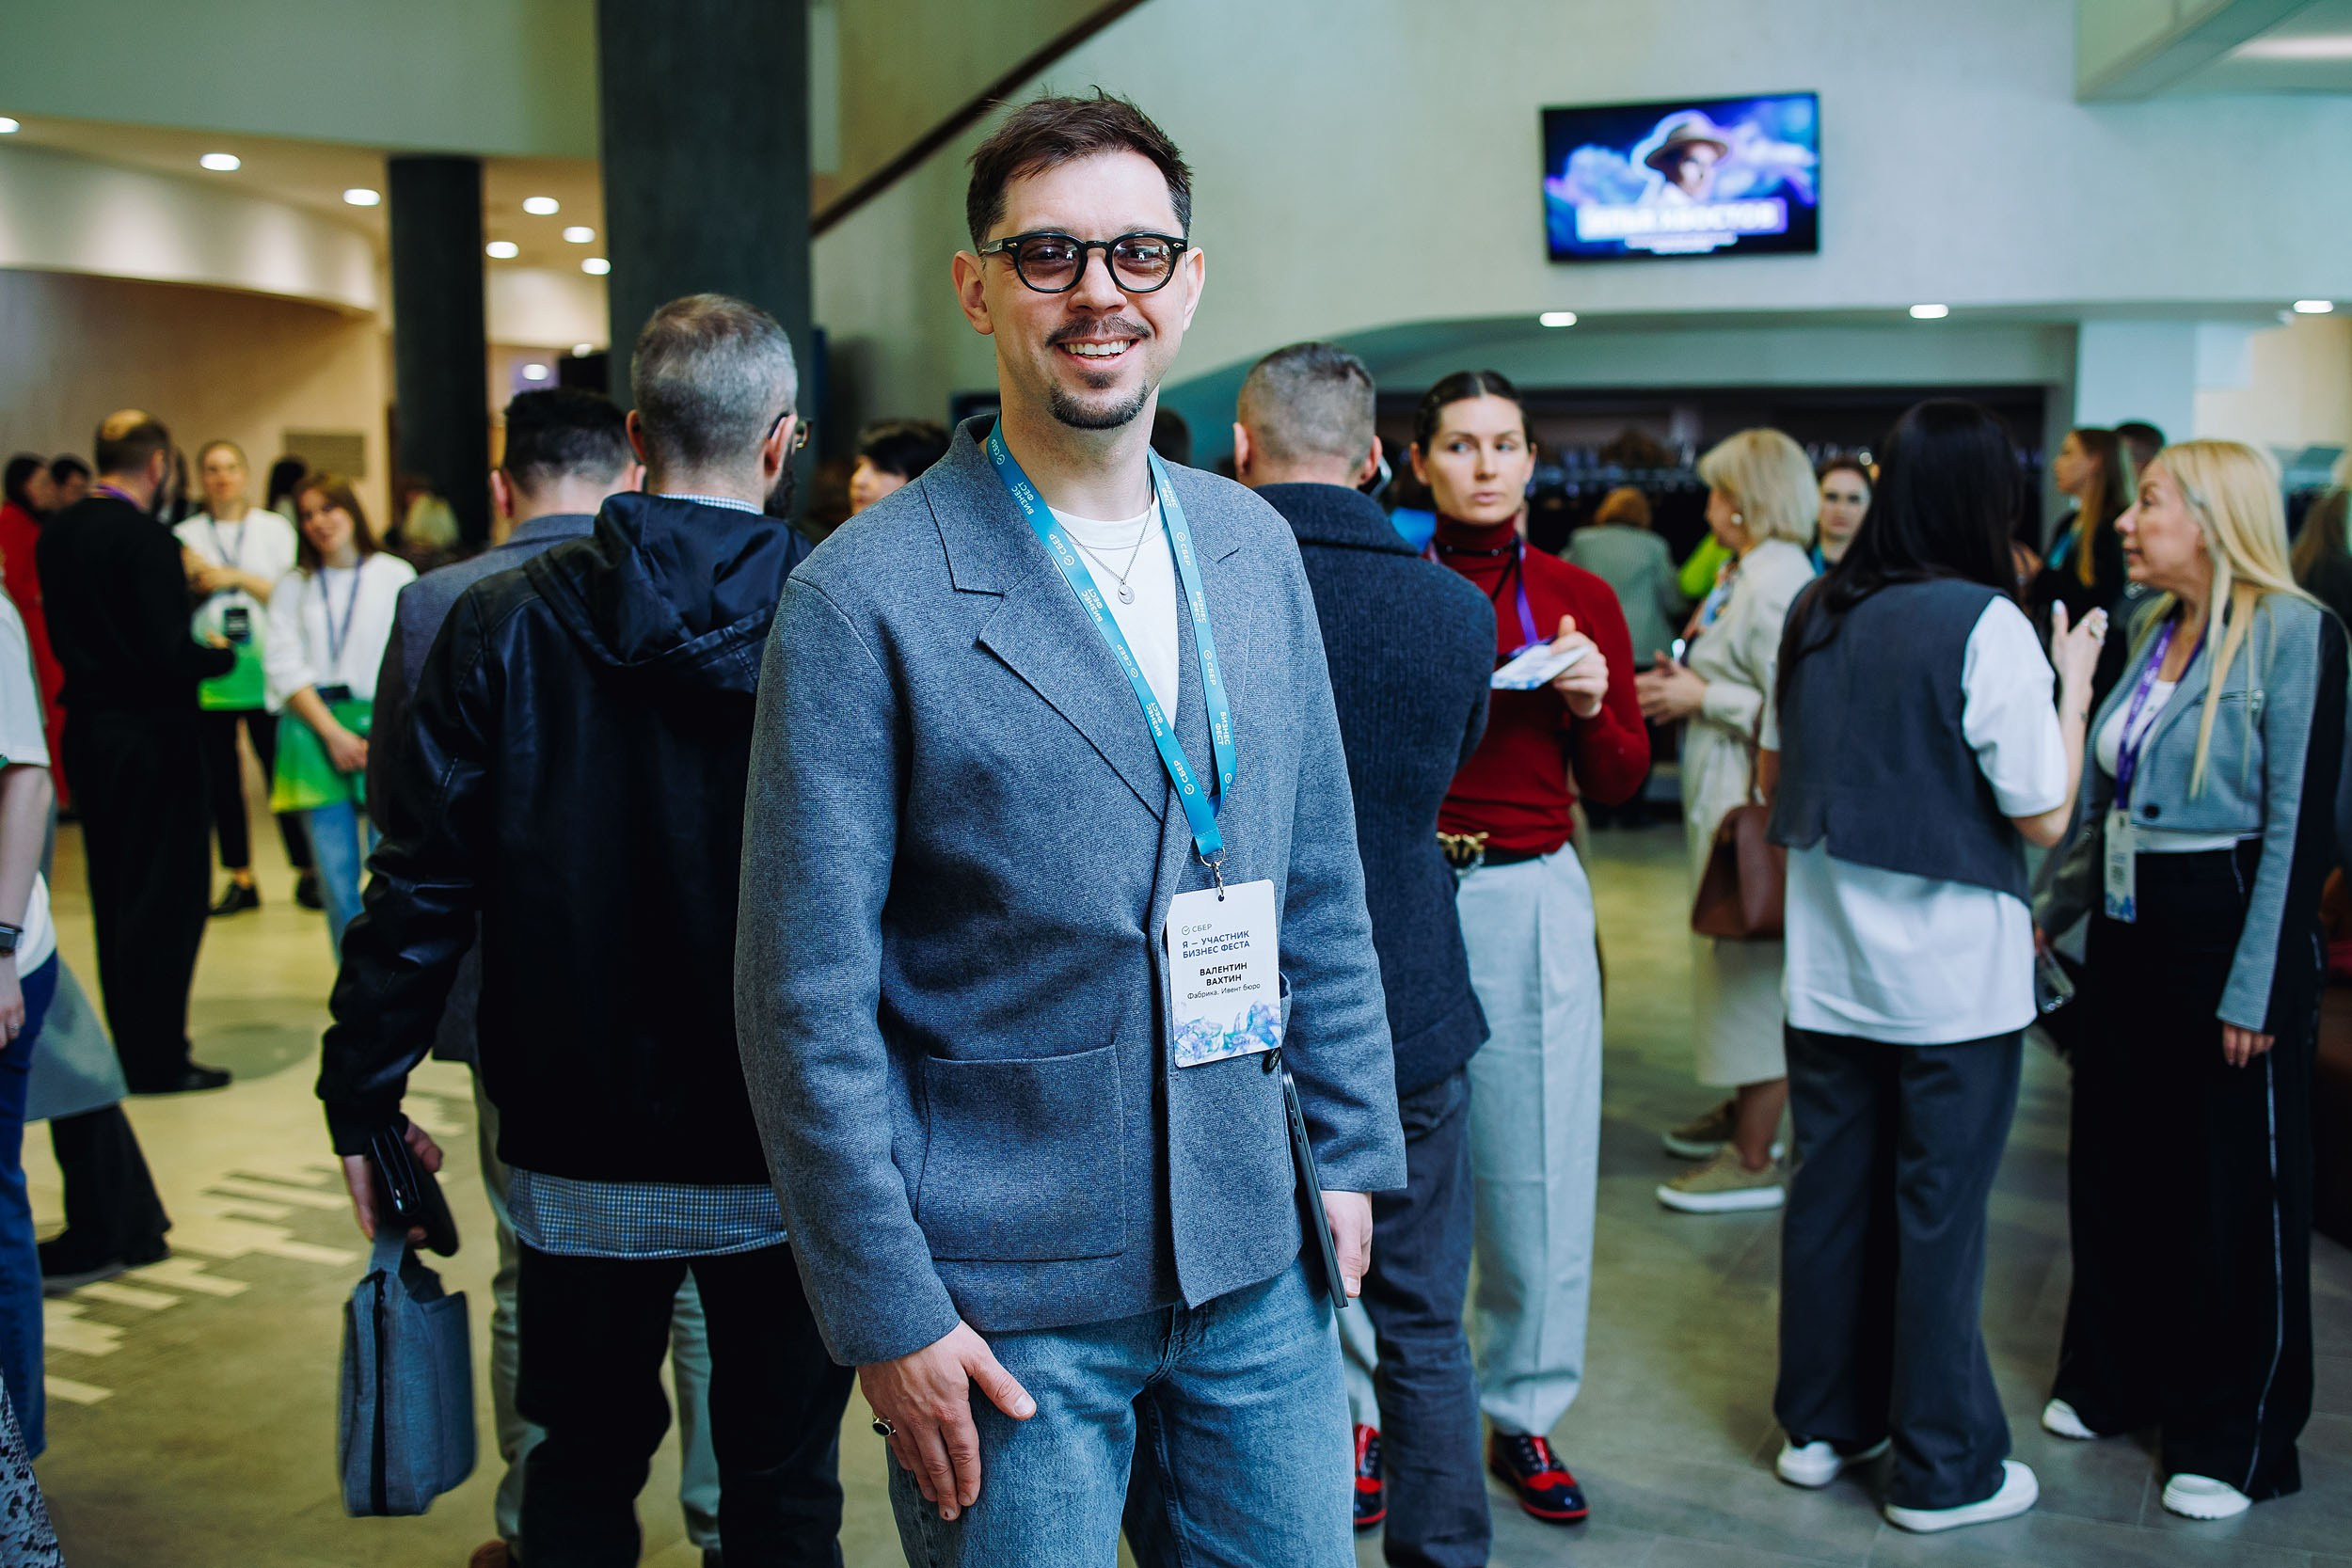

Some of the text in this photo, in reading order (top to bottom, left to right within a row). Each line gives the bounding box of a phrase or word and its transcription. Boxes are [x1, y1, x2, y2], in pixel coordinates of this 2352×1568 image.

[1011, 485, 1034, 515] БИЗНЕС
[1017, 482, 1034, 501] ФЕСТ
[1049, 533, 1067, 555] СБЕР
[1181, 543, 1191, 566] СБЕР
[1081, 591, 1103, 623] БИЗНЕС
[1088, 588, 1103, 610] ФЕСТ
[1196, 591, 1207, 624] БИЗНЕС
[1193, 601, 1201, 624] ФЕСТ
[1117, 643, 1132, 667] СБЕР
[1207, 661, 1216, 686] СБЕР
[1145, 705, 1163, 737] БИЗНЕС
[1151, 702, 1164, 723] ФЕСТ
[1215, 722, 1224, 746] ФЕСТ
[1220, 711, 1231, 746] БИЗНЕС
[1173, 760, 1188, 783] СБЕР
[1182, 941, 1188, 949] Я
[1200, 930, 1249, 945] УЧАСТНИК
[1192, 923, 1212, 933] СБЕР
[1183, 940, 1250, 958] БИЗНЕС ФЕСТА
[1200, 961, 1248, 976] ВАЛЕНТИН
[1187, 983, 1261, 1000] Фабрика. Ивент бюро
[1206, 974, 1242, 987] ВАХТИН
